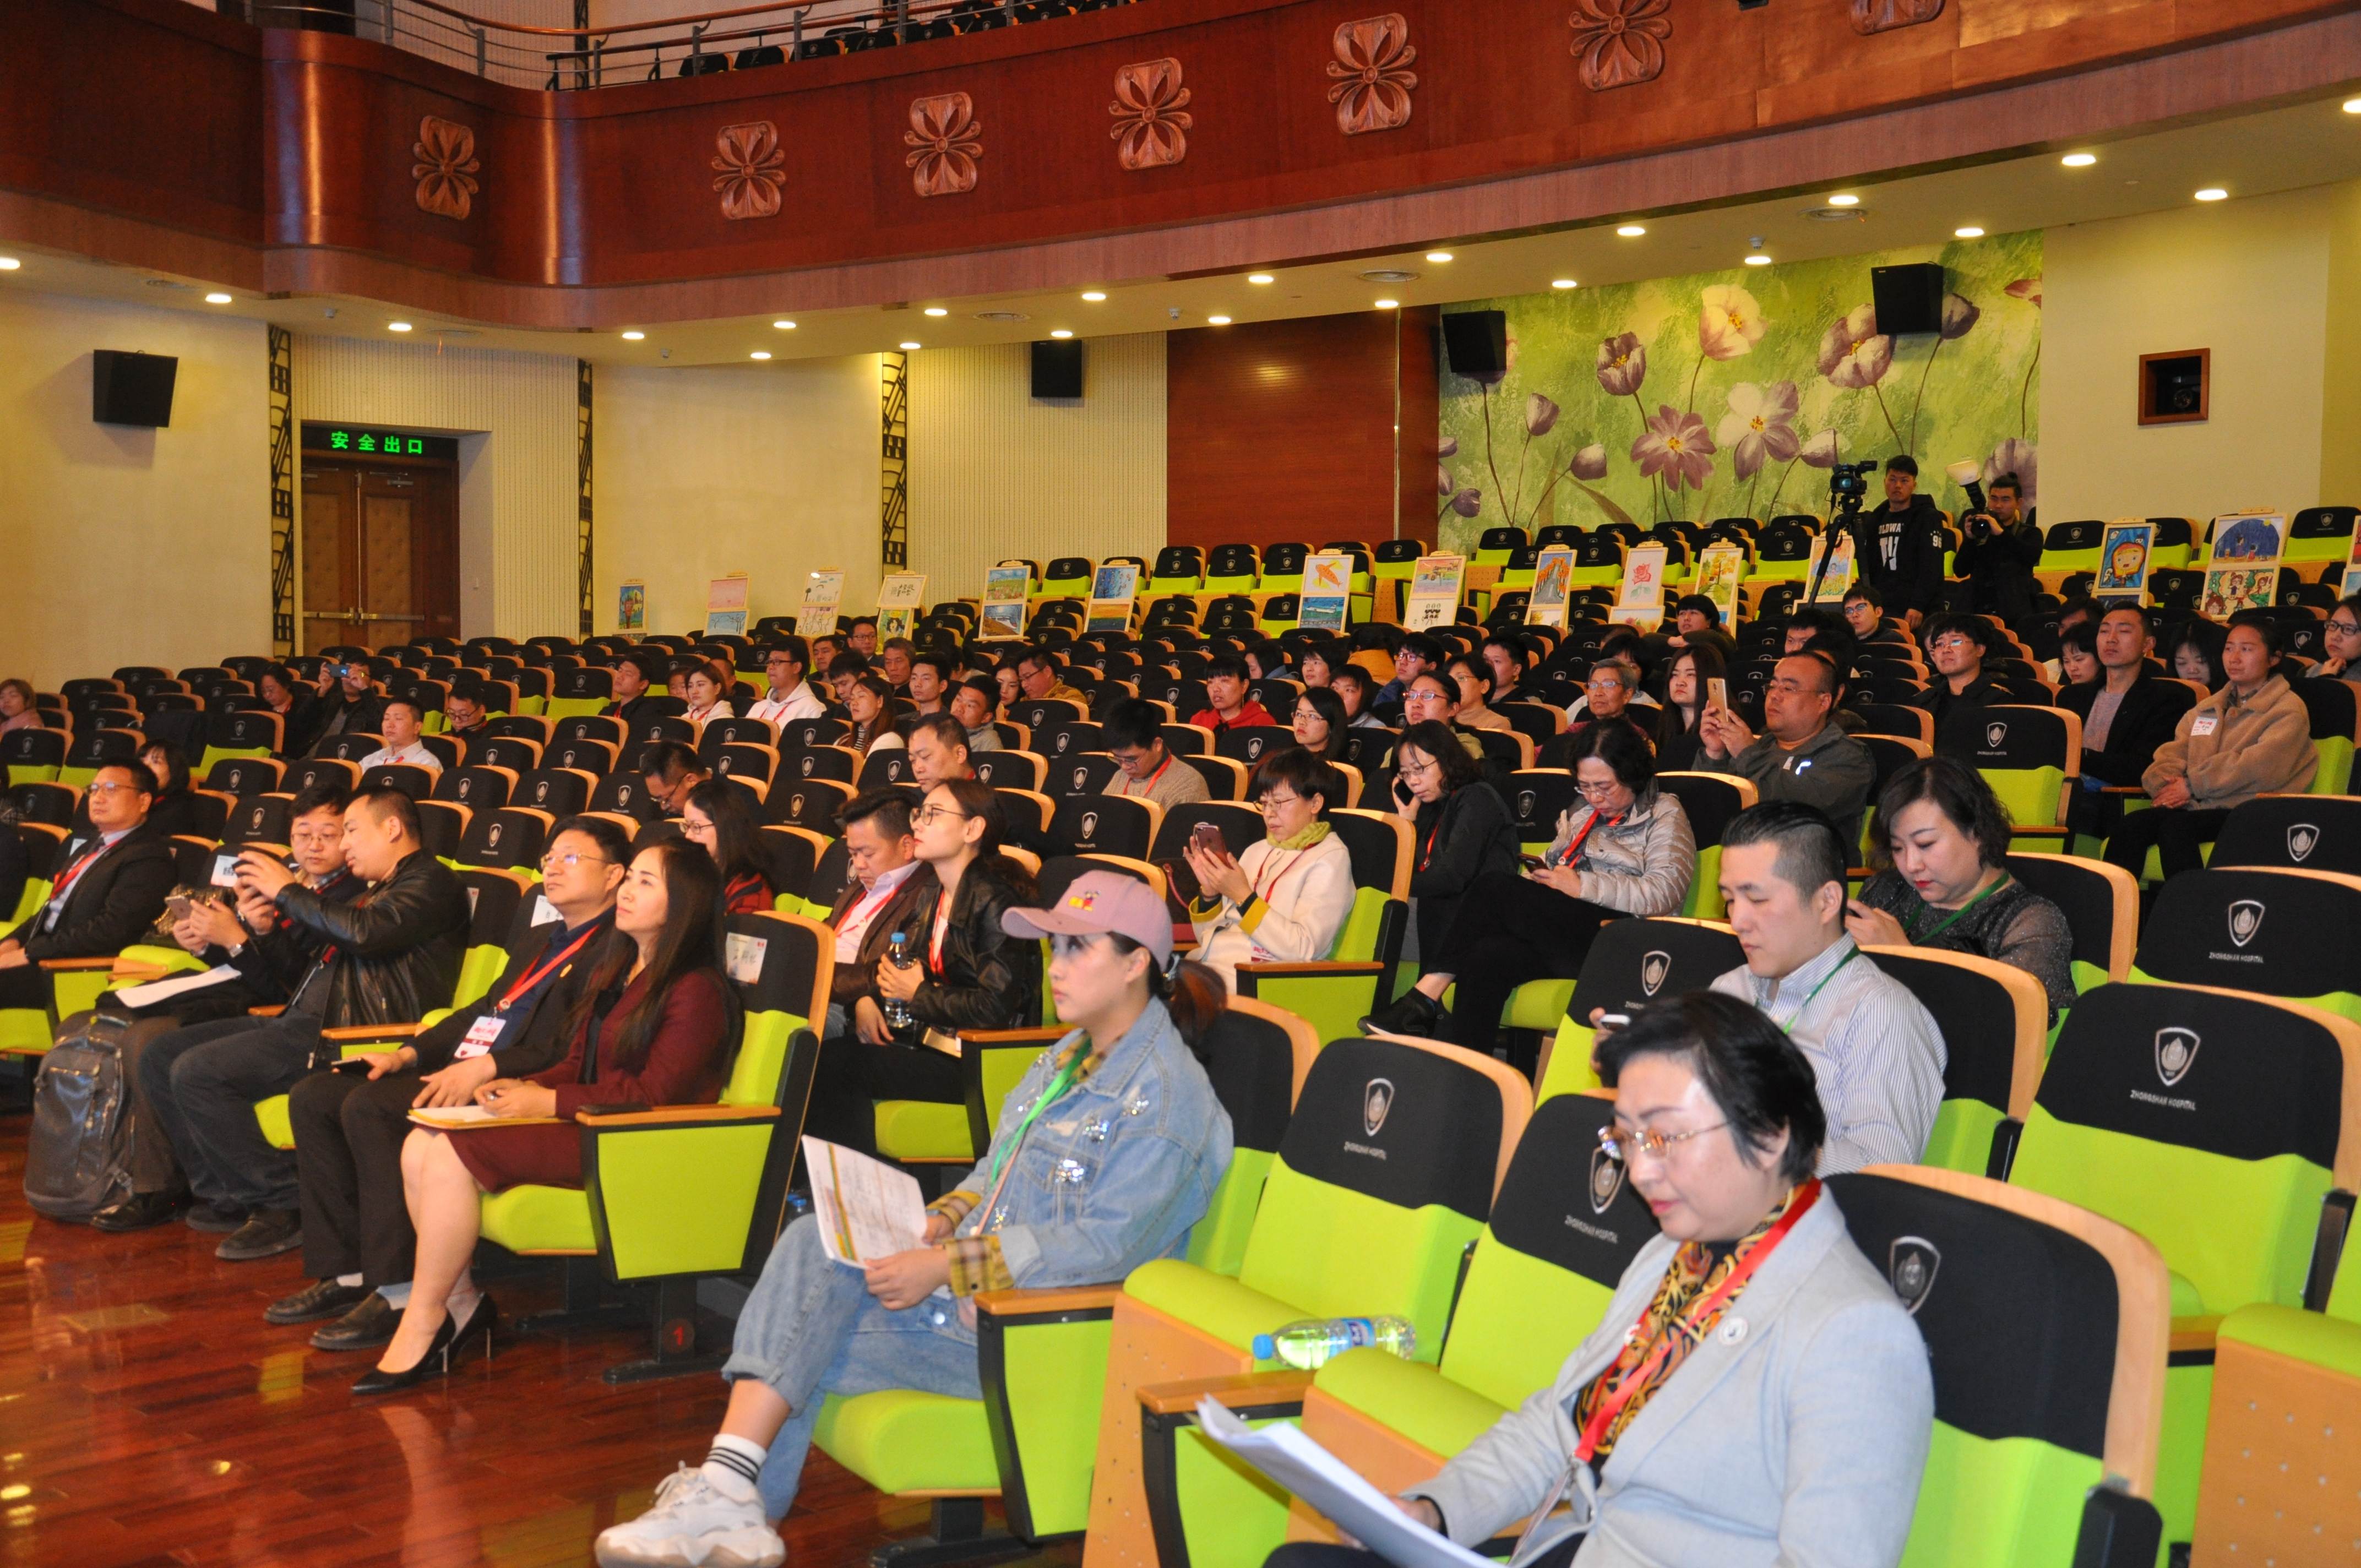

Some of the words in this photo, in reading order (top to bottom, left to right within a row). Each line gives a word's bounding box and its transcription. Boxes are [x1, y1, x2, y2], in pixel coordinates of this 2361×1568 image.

[331, 431, 423, 454] 安全出口
[2130, 1090, 2168, 1106] ZHONGSHAN
[2168, 1098, 2196, 1111] HOSPITAL
[673, 1325, 683, 1346] 1
